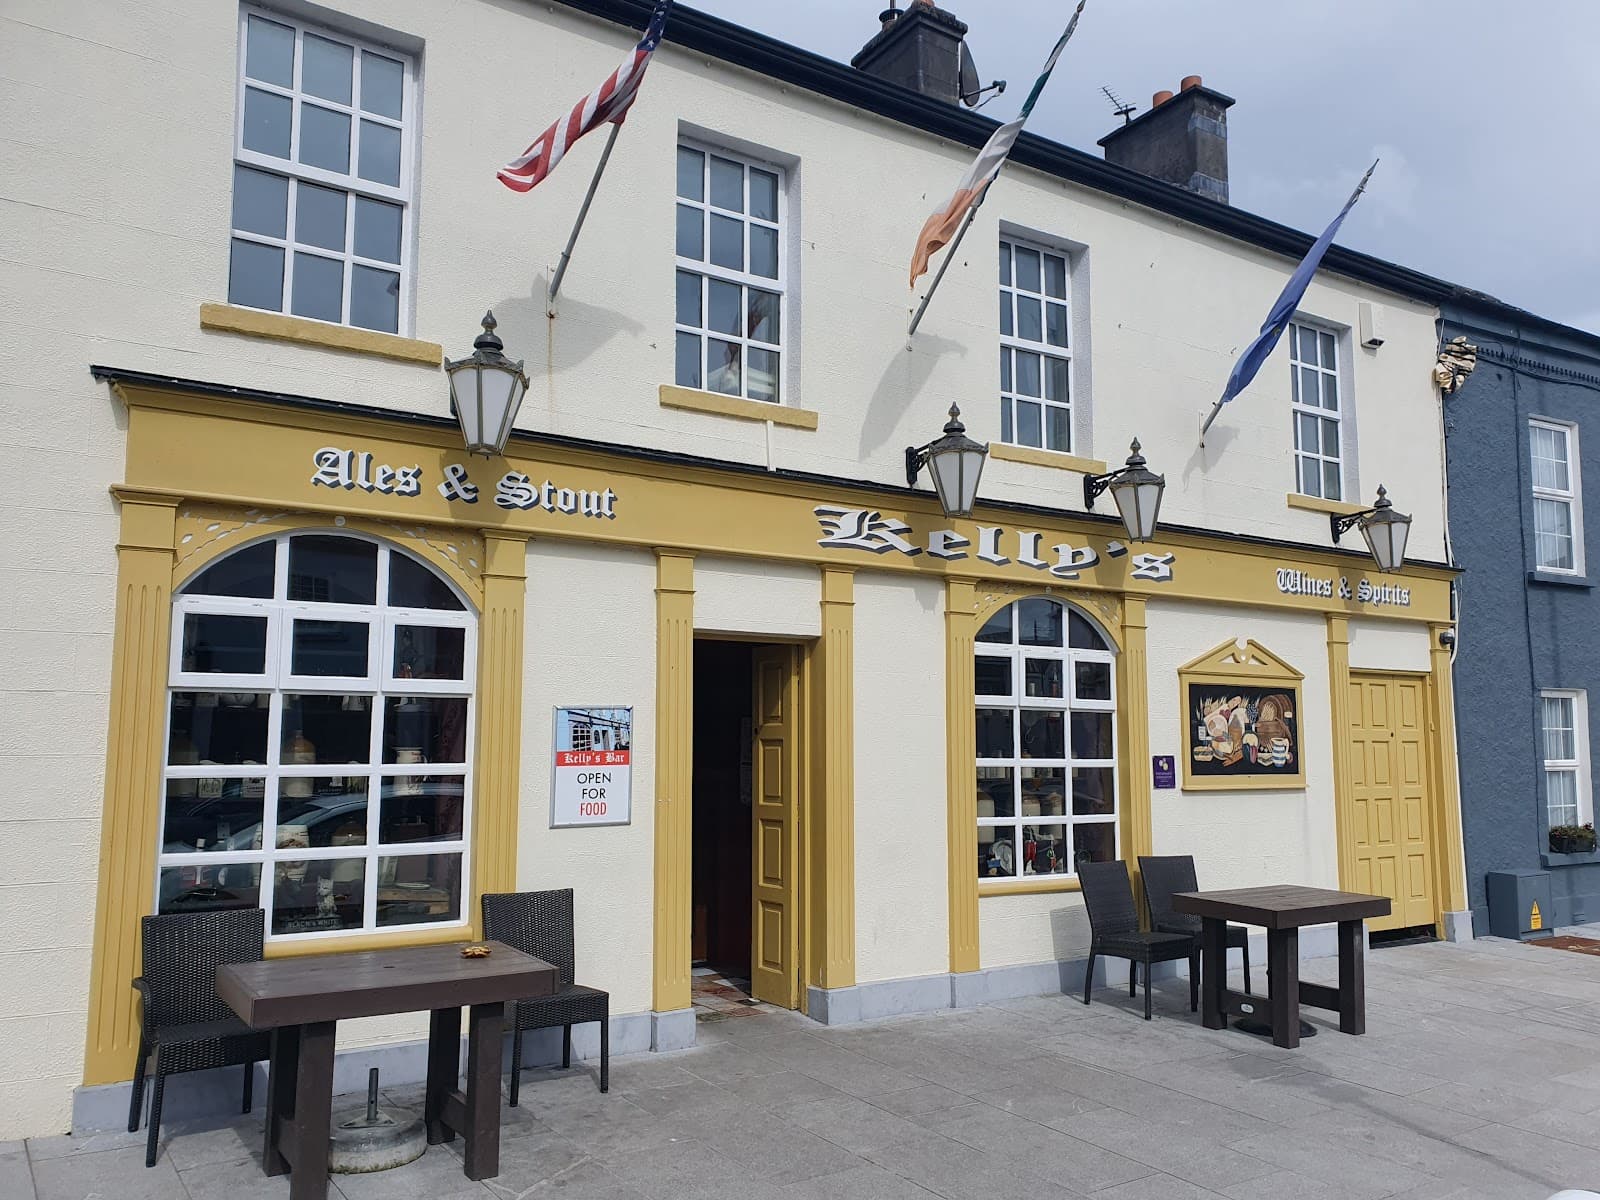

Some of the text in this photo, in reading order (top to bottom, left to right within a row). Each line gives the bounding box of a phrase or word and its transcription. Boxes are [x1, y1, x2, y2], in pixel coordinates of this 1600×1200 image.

[311, 446, 618, 520] Ales & Stout
[813, 505, 1175, 583] Kelly's
[1276, 567, 1411, 607] Wines & Spirits
[564, 752, 625, 765] Kelly's Bar
[577, 773, 612, 784] OPEN
[582, 788, 606, 799] FOR
[580, 802, 607, 816] FOOD
